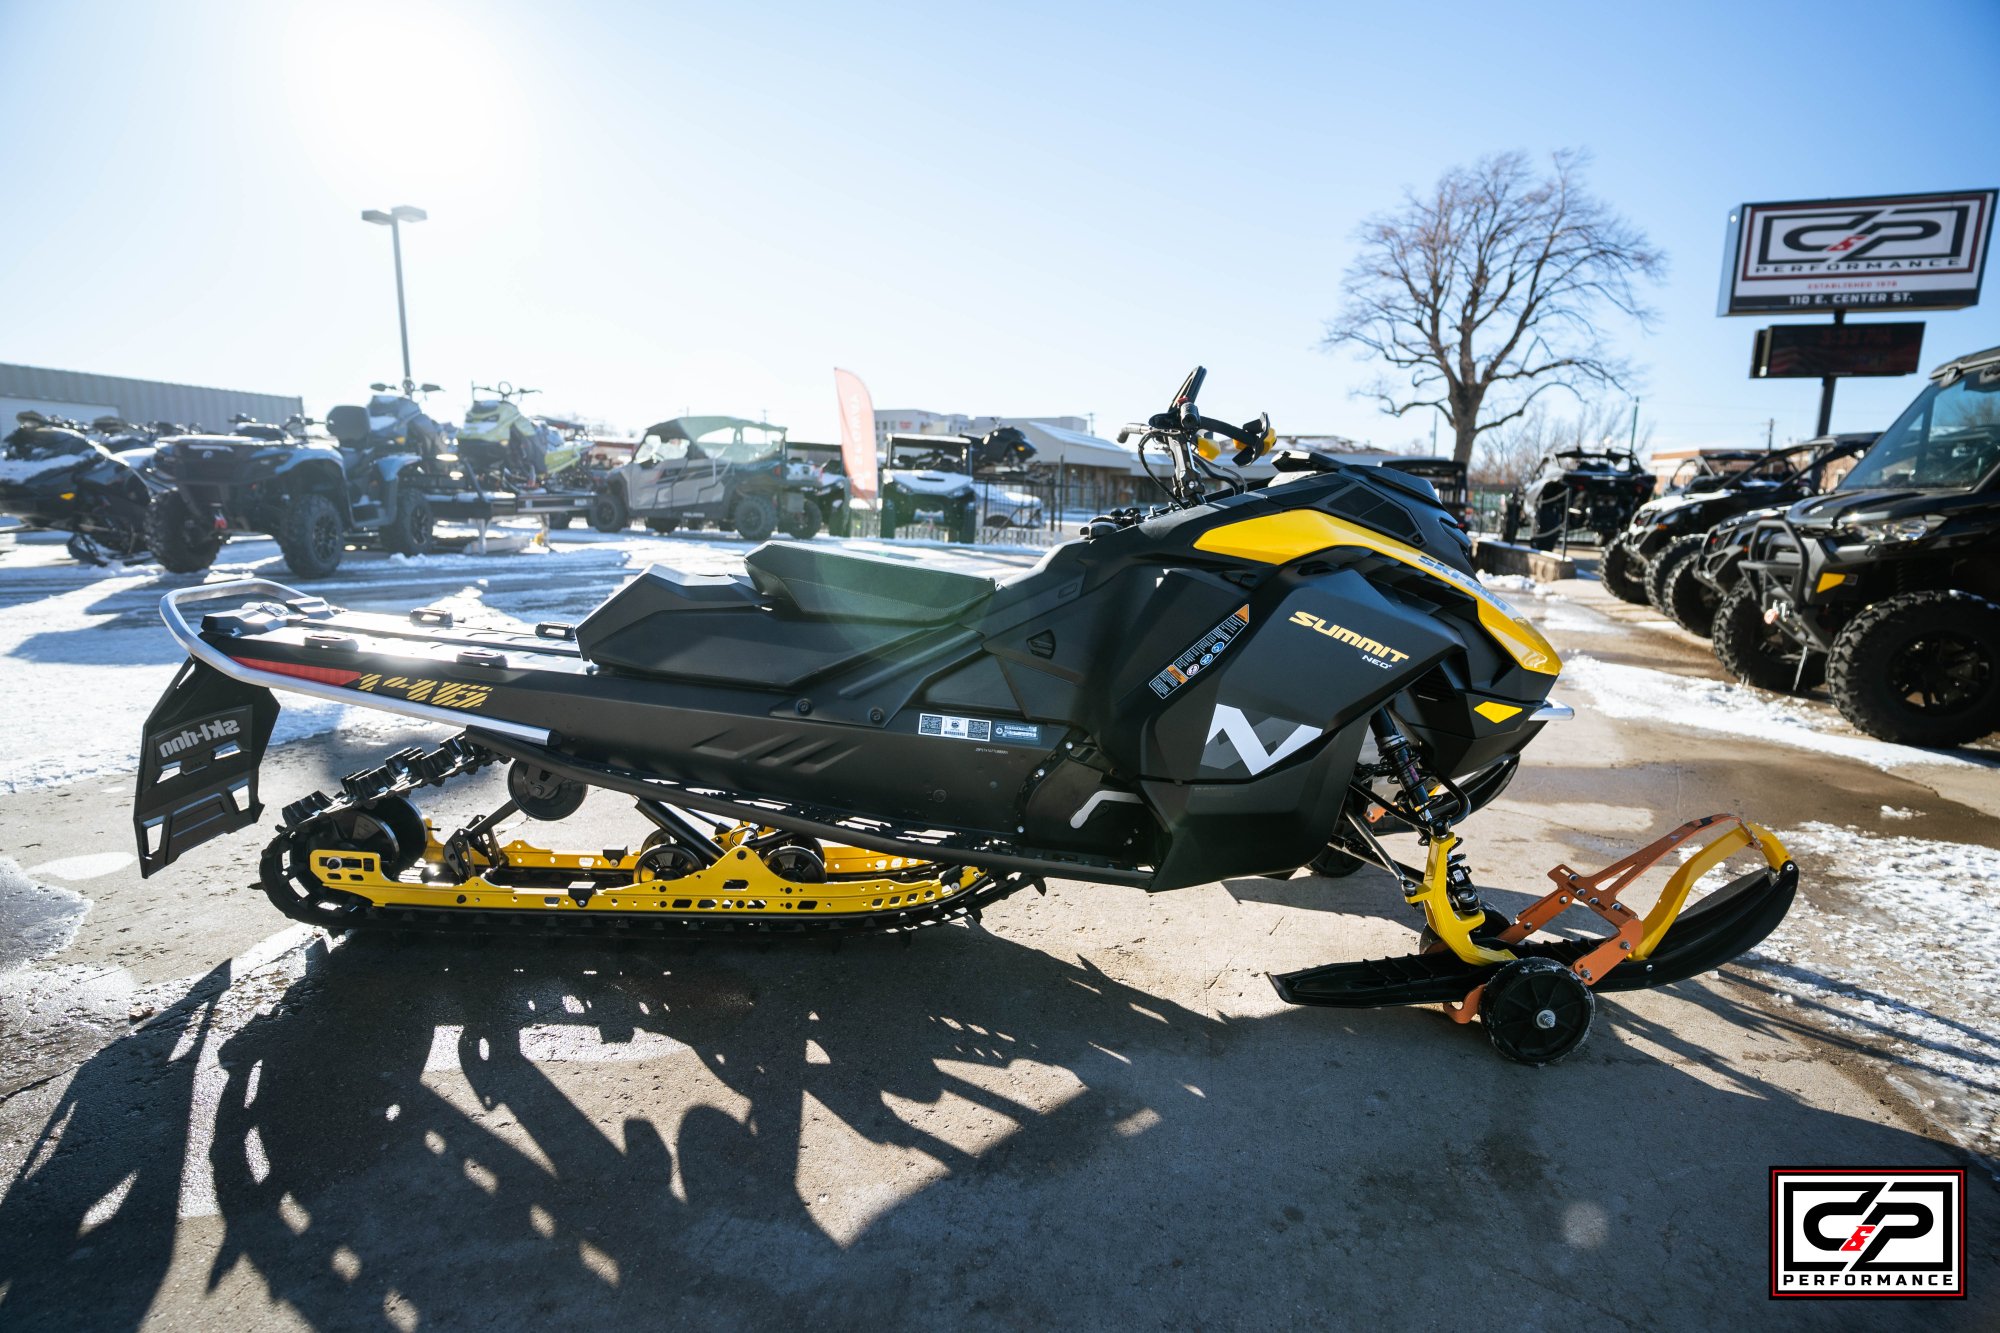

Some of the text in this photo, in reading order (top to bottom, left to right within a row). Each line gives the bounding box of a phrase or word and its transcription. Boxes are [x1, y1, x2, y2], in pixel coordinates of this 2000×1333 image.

[1755, 257, 1961, 273] PERFORMANCE
[1807, 281, 1873, 290] ESTABLISHED
[1789, 291, 1914, 305] 110 E. CENTER ST.
[1289, 610, 1410, 663] SUMMIT
